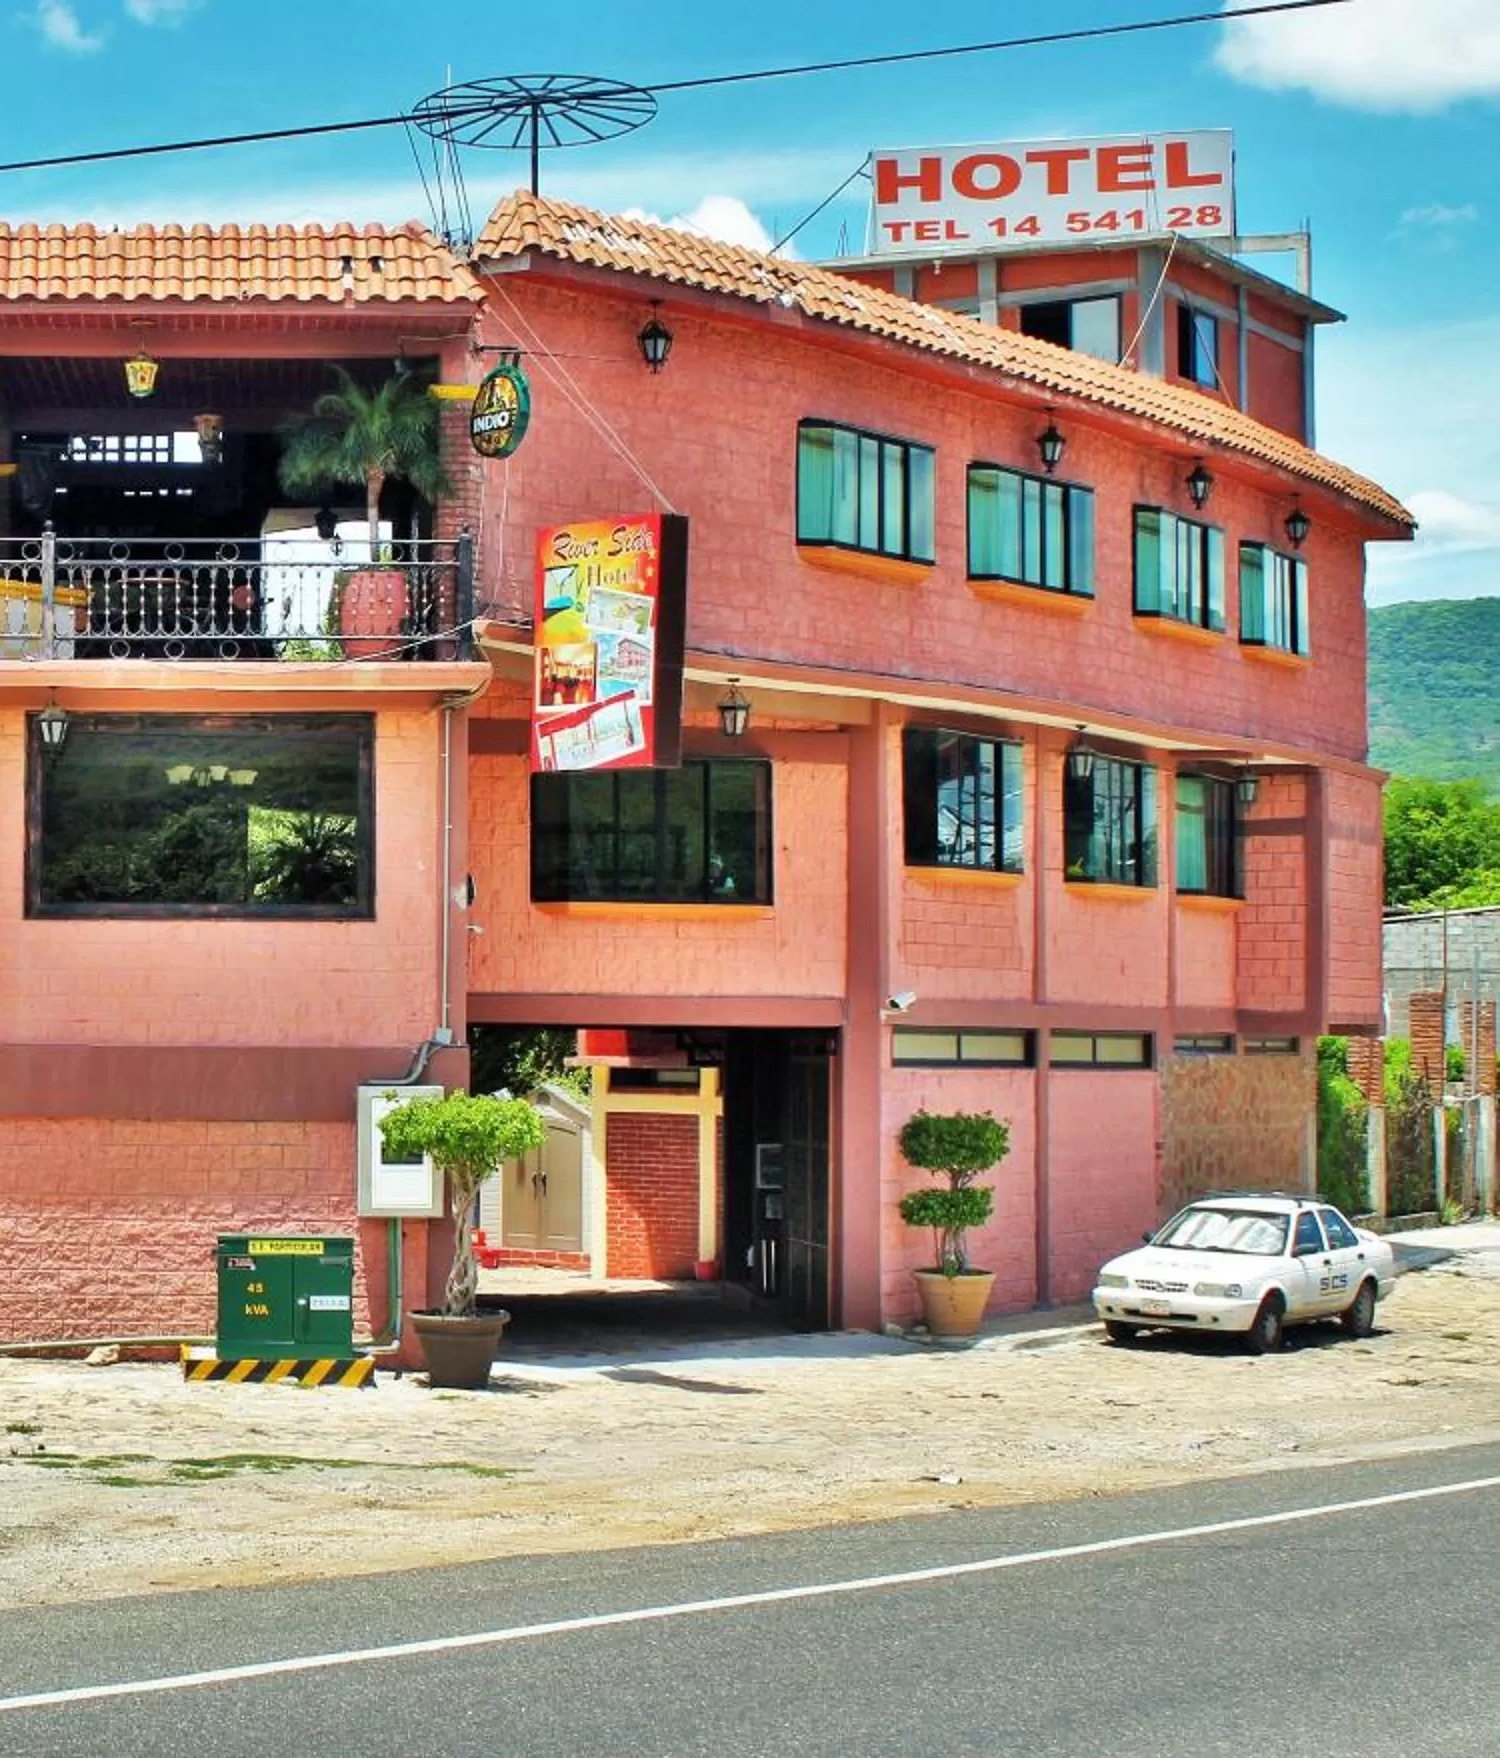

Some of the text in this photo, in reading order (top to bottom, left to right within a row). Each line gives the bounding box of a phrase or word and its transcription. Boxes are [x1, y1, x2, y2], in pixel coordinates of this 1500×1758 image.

[876, 141, 1222, 204] HOTEL
[882, 204, 1222, 242] TEL 14 541 28
[472, 411, 510, 434] INDIO
